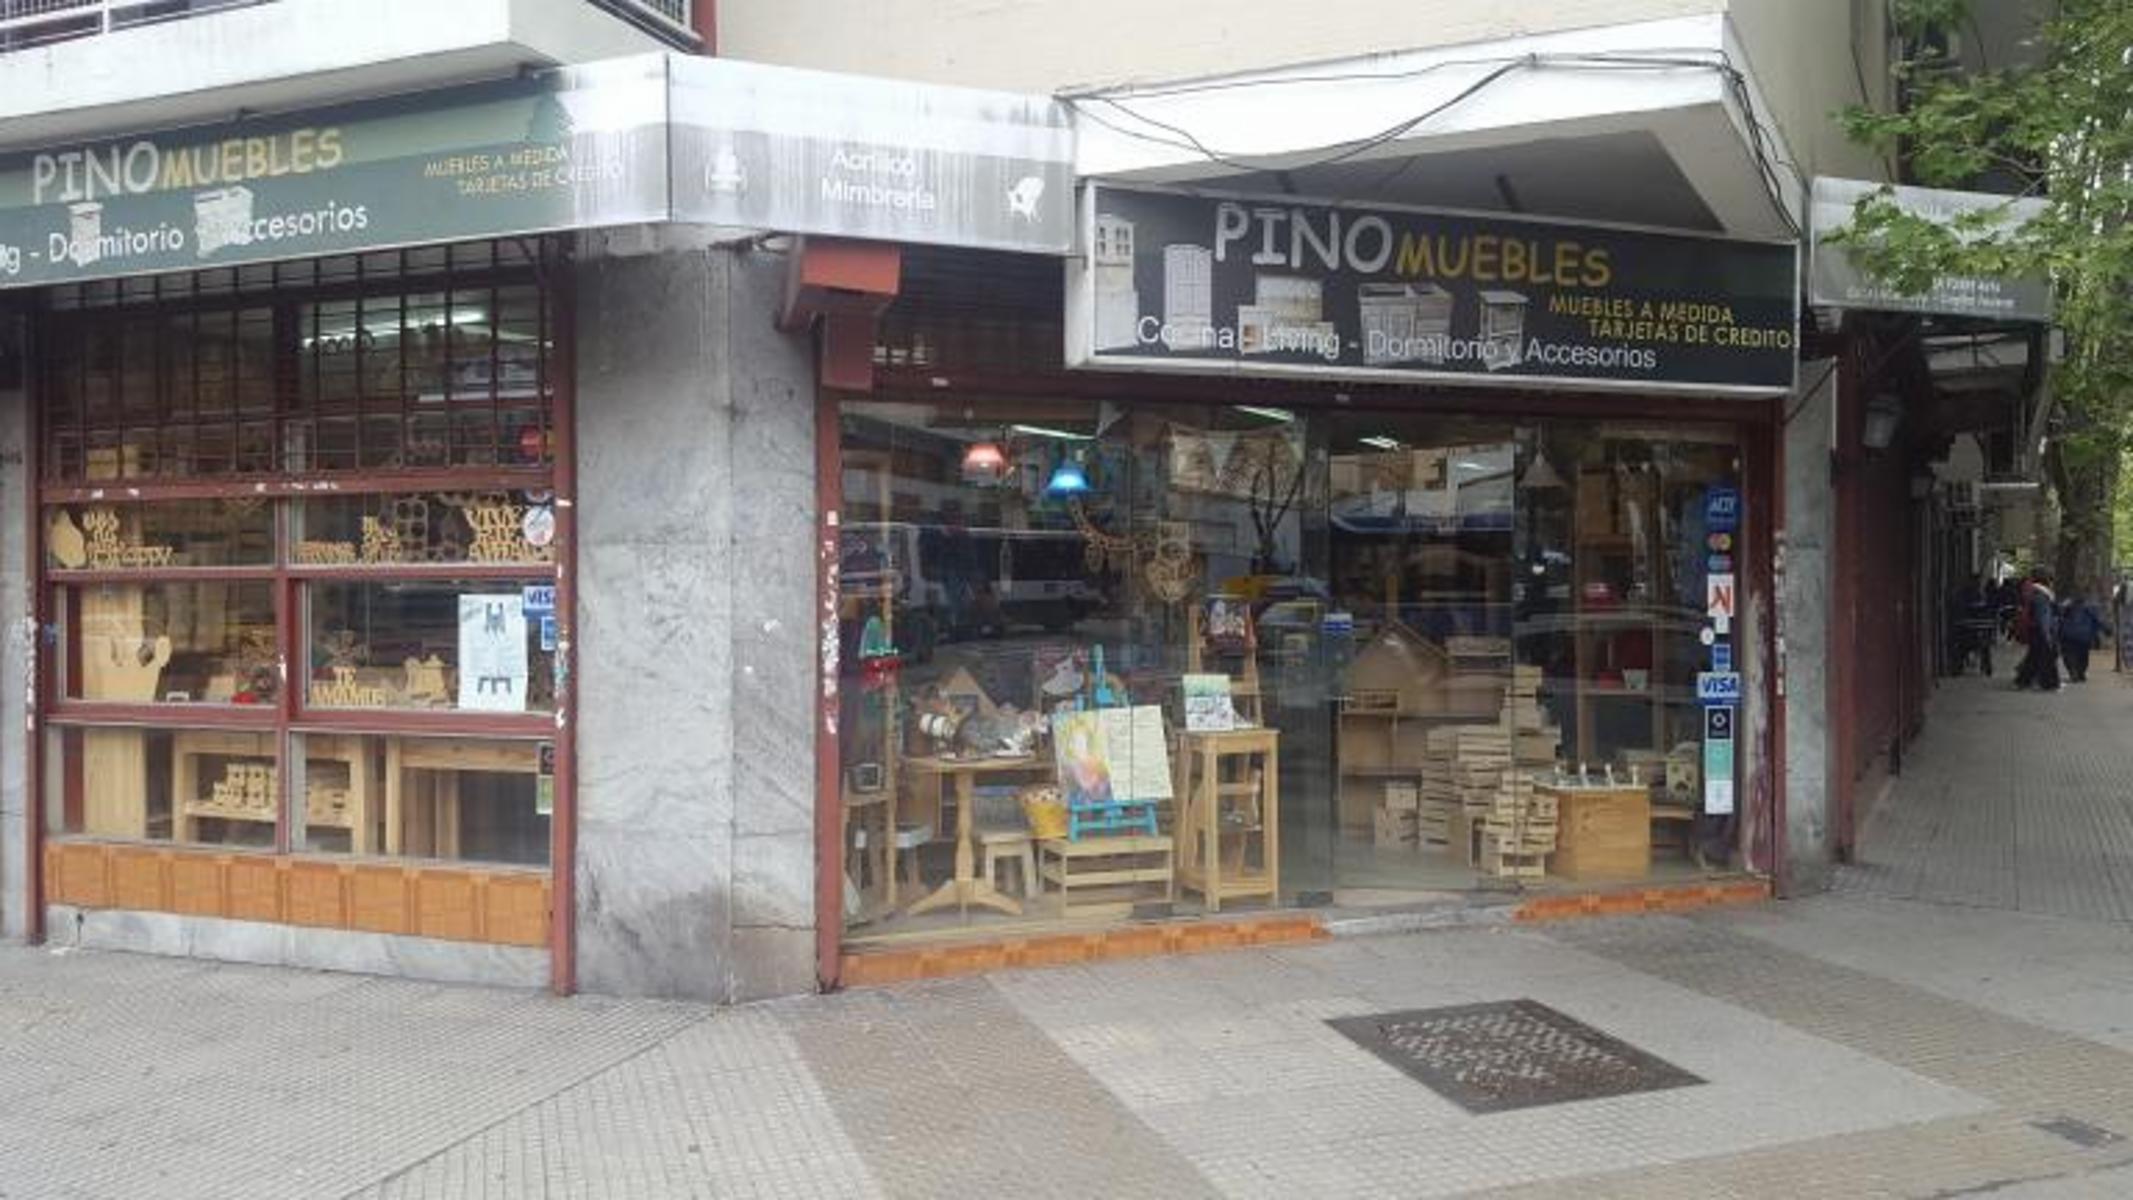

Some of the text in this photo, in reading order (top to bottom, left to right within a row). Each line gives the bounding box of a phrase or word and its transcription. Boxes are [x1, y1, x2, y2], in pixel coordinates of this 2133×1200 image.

[34, 128, 343, 206] PINO MUEBLES
[424, 155, 490, 178] MUEBLES
[1215, 203, 1612, 288] PINO MUEBLES
[1549, 295, 1734, 325] MUEBLES A MEDIDA
[1368, 329, 1498, 359] Dormitorio
[1525, 337, 1657, 369] Accesorios
[1589, 318, 1791, 349] TARJETAS DE CREDITO
[1702, 677, 1737, 693] VISA
